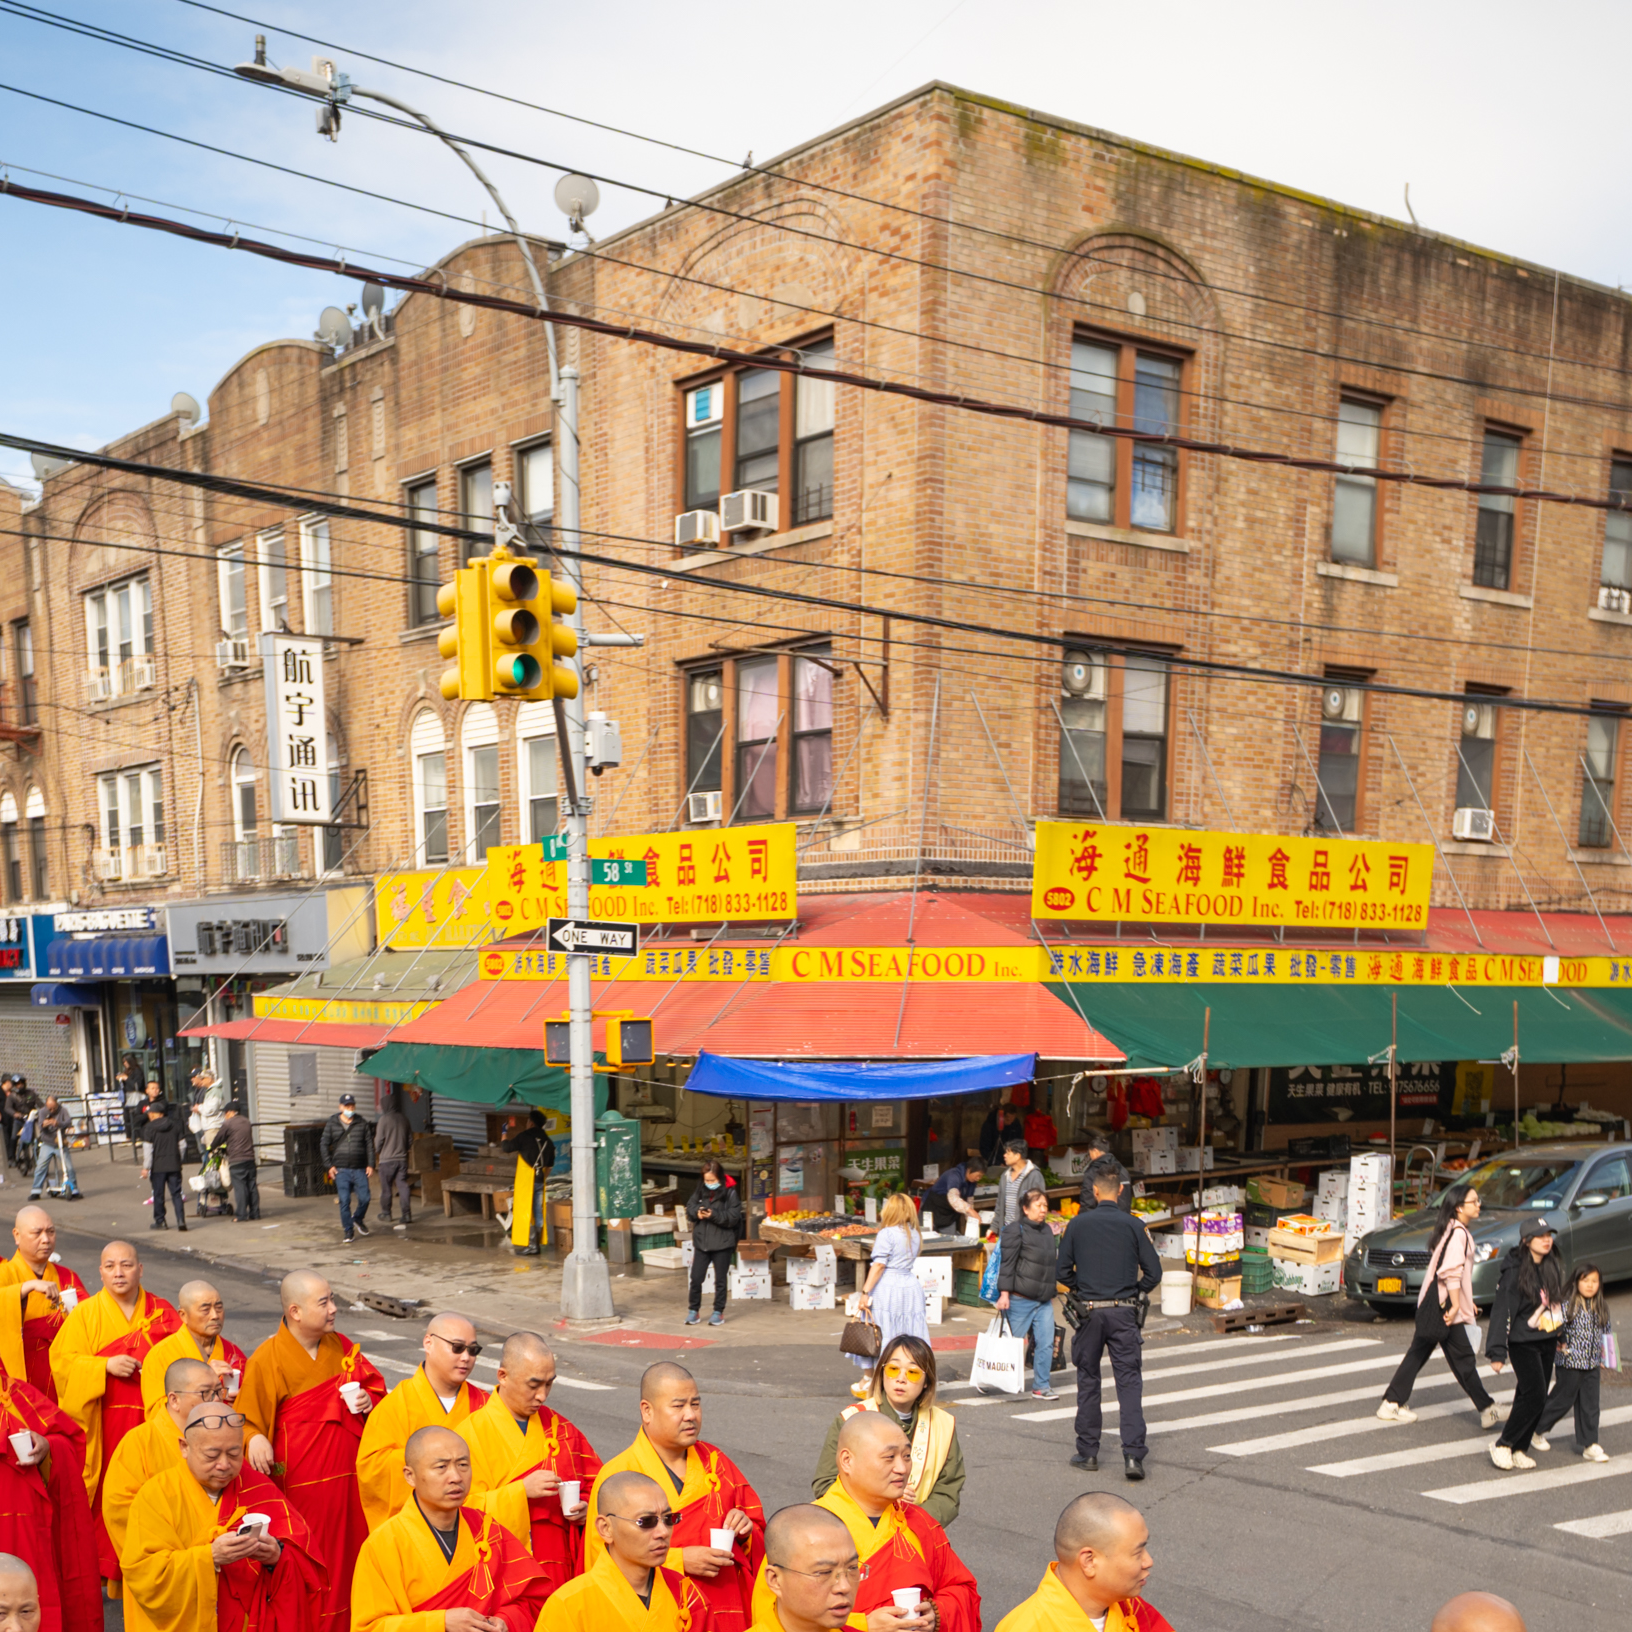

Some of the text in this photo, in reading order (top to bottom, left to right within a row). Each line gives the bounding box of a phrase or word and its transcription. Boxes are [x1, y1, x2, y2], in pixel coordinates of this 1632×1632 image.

[283, 647, 321, 812] 航宇通讯
[507, 839, 768, 894] 海通食品公司
[603, 862, 634, 883] 58 St
[1069, 829, 1409, 896] 海通海鮮食品公司
[520, 898, 530, 919] C
[535, 897, 549, 918] M
[555, 896, 627, 918] SEOOD
[633, 895, 659, 916] Inc.
[1046, 892, 1071, 907] 5802
[1086, 886, 1102, 913] C
[1111, 888, 1132, 914] M
[1141, 888, 1244, 917] SEAFOOD
[1252, 896, 1284, 918] Inc.
[562, 929, 628, 946] ONE WAY
[792, 950, 1023, 978] C M SEAFOOD Inc.
[1213, 952, 1276, 977] 蔬菜瓜果
[1484, 957, 1496, 981] C
[1500, 958, 1514, 982] M
[1518, 957, 1588, 982] SEAOOD
[847, 1155, 901, 1172] 天生果菜
[986, 1360, 1016, 1372] MADDEN
